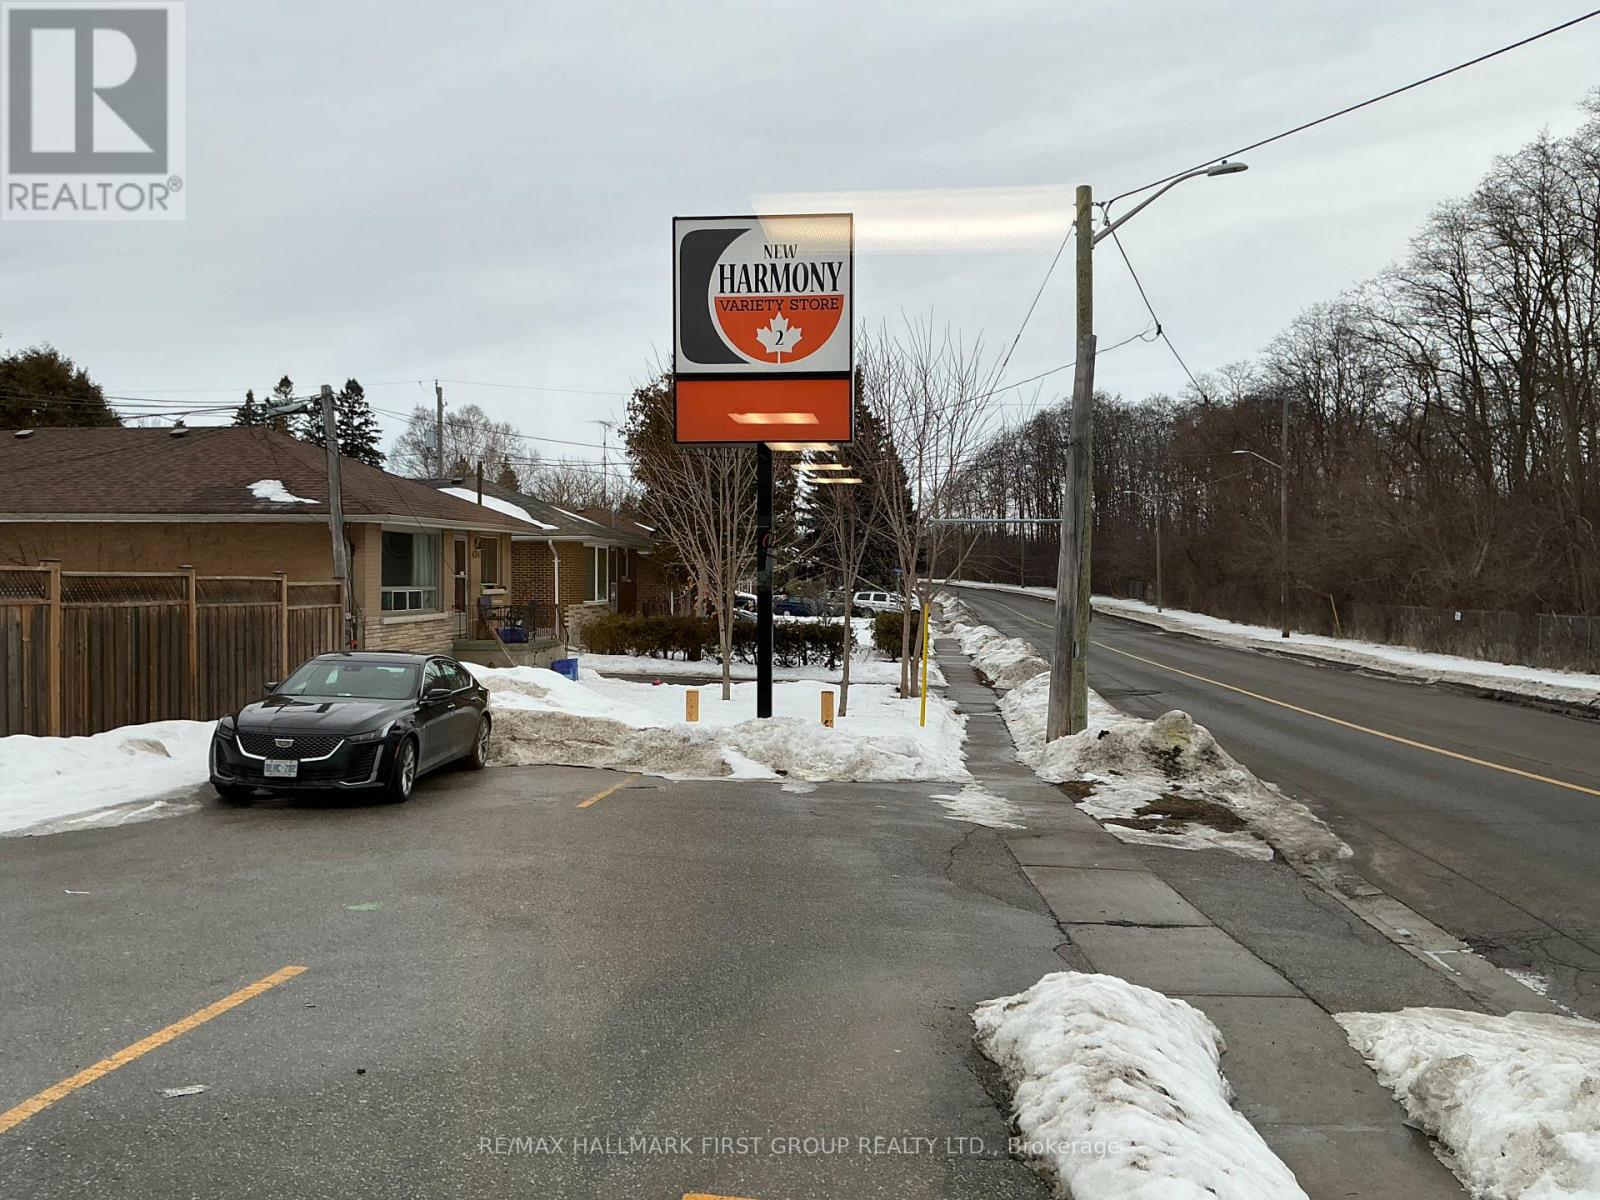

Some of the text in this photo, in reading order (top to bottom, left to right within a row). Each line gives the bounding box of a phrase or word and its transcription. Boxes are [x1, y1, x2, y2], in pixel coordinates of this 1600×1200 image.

[763, 243, 798, 260] NEW
[718, 261, 843, 294] HARMONY
[719, 297, 839, 312] VARIETY STORE
[775, 330, 784, 346] 2
